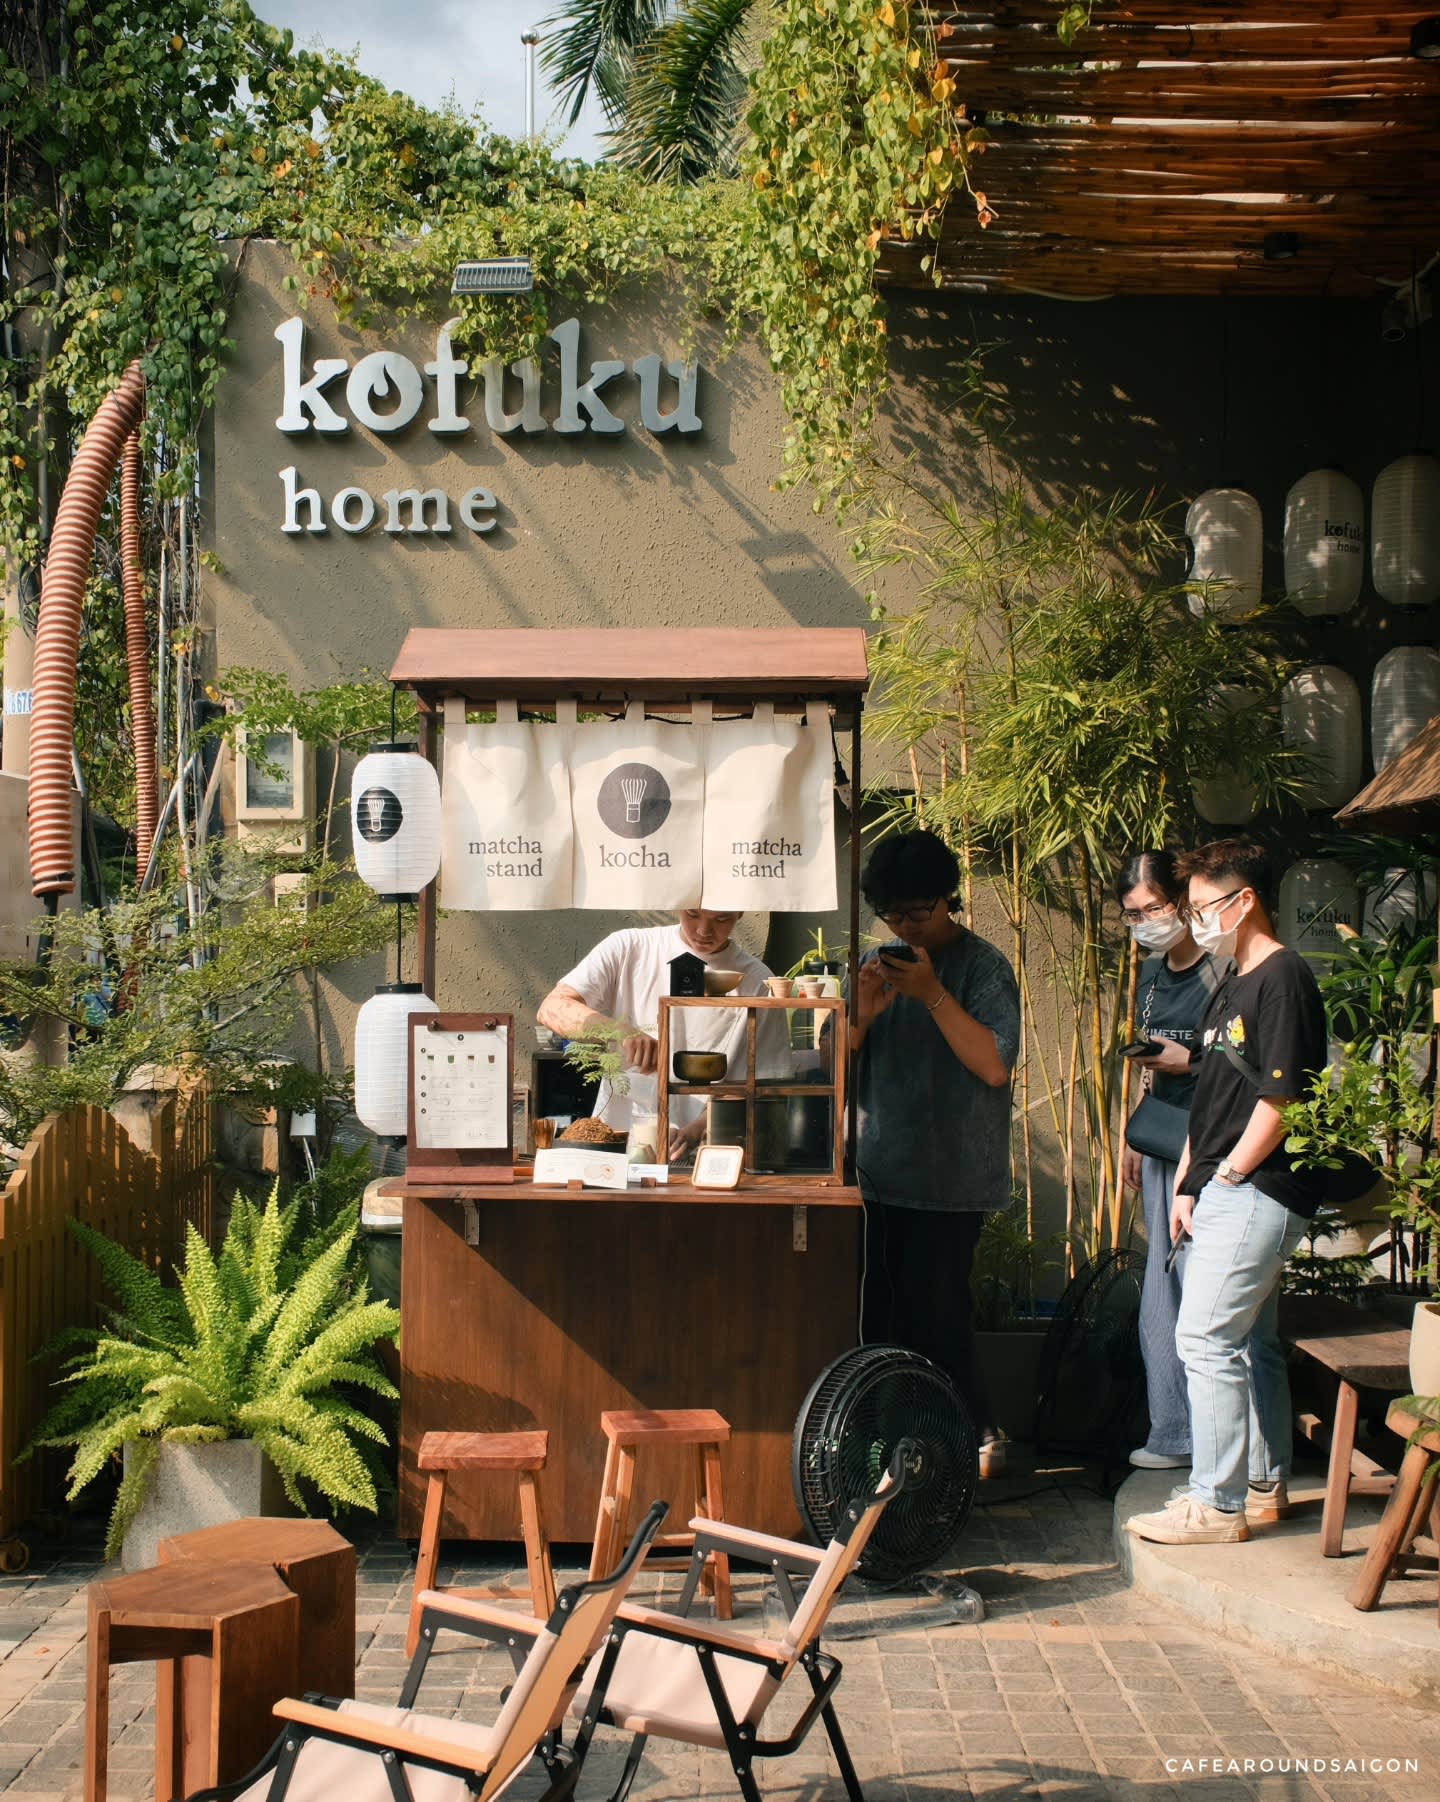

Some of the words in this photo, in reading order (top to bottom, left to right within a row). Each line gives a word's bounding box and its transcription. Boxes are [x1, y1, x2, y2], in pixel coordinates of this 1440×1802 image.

[275, 317, 702, 433] kofuku
[278, 466, 498, 533] home
[468, 835, 543, 855] matcha
[731, 837, 802, 857] matcha
[599, 844, 672, 868] kocha
[486, 857, 543, 877] stand
[731, 860, 785, 879] stand
